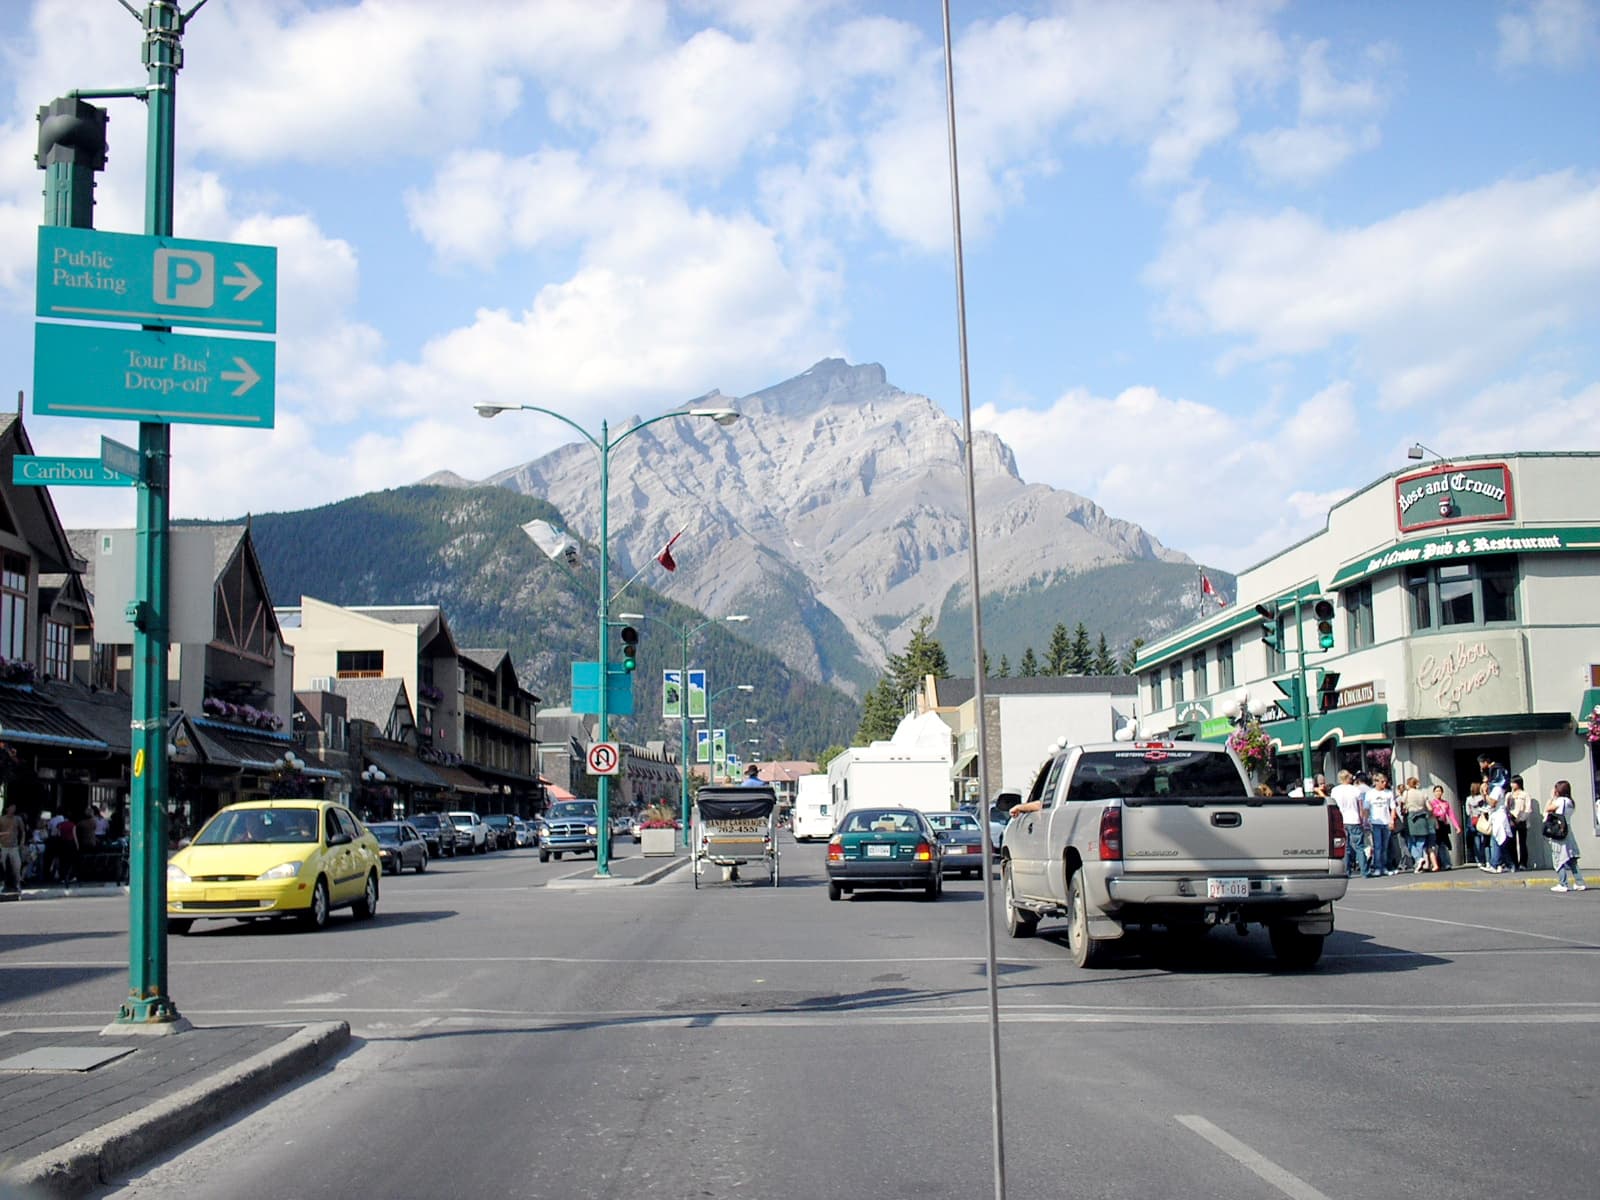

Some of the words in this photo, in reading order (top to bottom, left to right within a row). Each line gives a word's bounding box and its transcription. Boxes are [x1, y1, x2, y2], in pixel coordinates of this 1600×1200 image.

[53, 247, 114, 270] Public
[52, 268, 127, 294] Parking
[166, 256, 202, 299] P
[124, 349, 167, 369] Tour
[172, 353, 207, 371] Bus
[125, 372, 212, 395] Drop-off
[23, 462, 94, 480] Caribou
[1398, 486, 1424, 513] Rose
[1425, 473, 1449, 495] and
[1450, 472, 1506, 501] Crown
[1421, 543, 1455, 560] Pub
[1455, 540, 1471, 554] &
[1472, 536, 1562, 554] Restaurant
[1435, 659, 1500, 711] Corner
